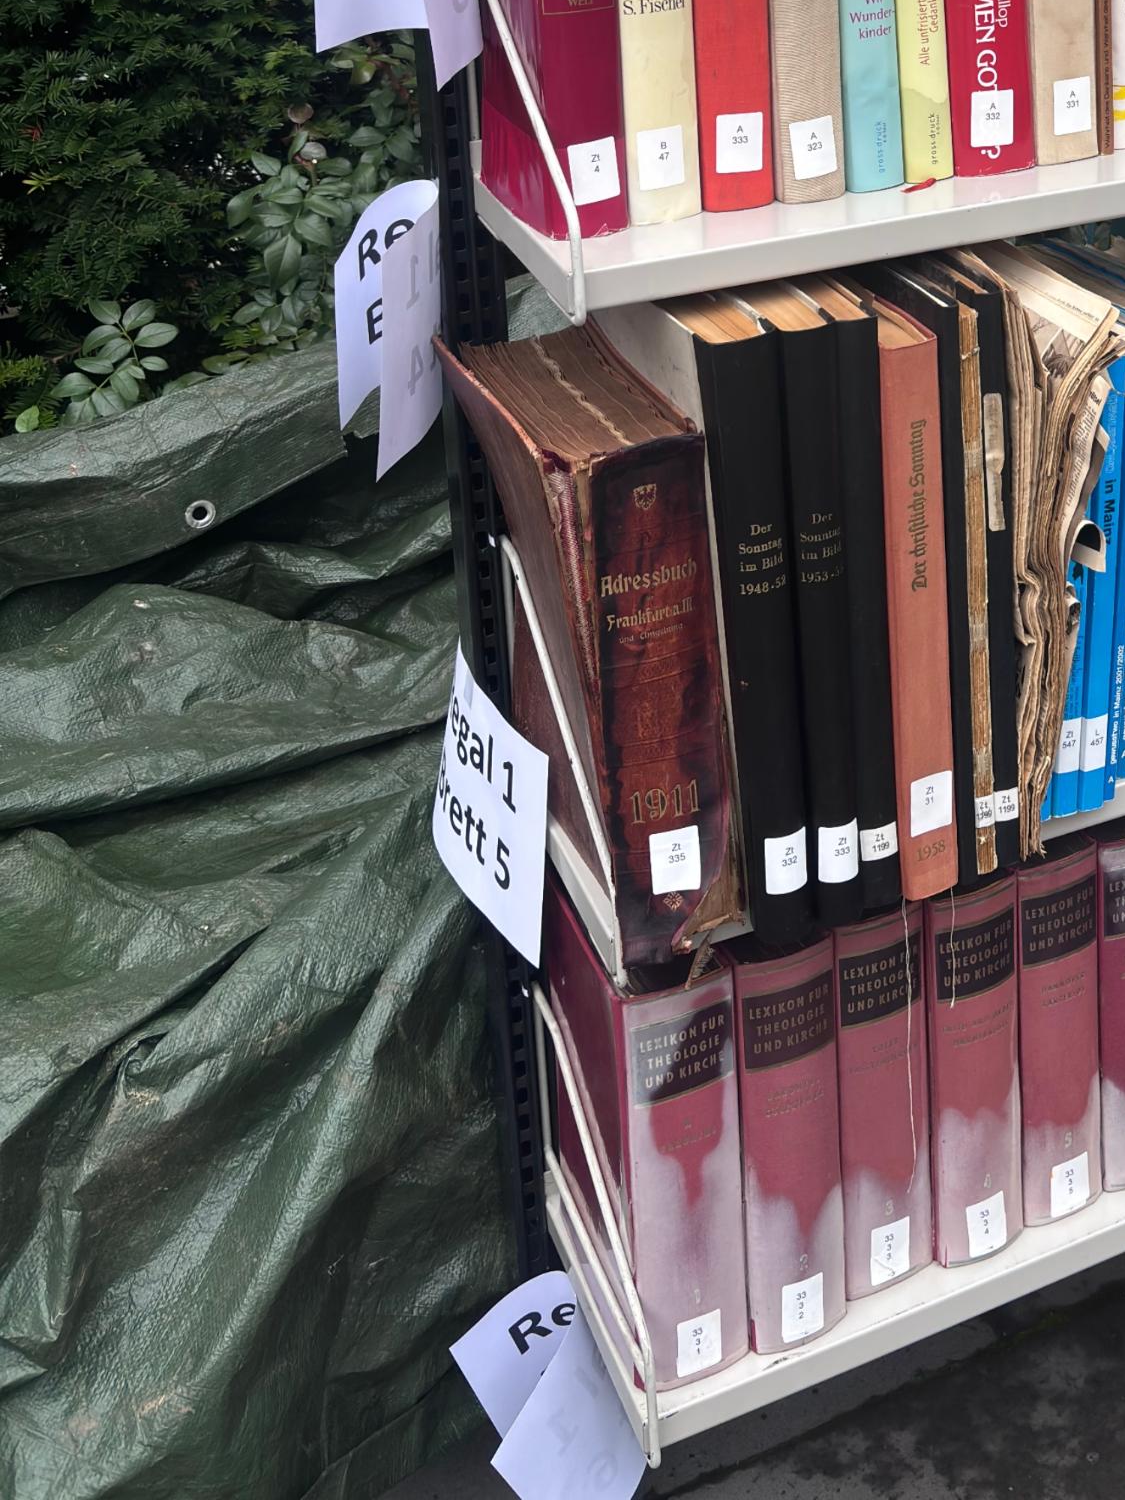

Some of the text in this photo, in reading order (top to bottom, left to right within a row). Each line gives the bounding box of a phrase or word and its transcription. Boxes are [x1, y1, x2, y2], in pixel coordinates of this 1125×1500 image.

[624, 5, 635, 14] S.
[849, 9, 895, 23] Wunder-
[858, 26, 892, 39] kinder
[984, 111, 1001, 120] 332
[731, 134, 749, 144] 333
[806, 141, 823, 151] 323
[600, 557, 697, 598] Adressbuch
[451, 686, 516, 813] egal 1
[630, 779, 701, 825] 1911
[494, 836, 510, 890] 5
[639, 1025, 698, 1054] LEXIKON
[647, 1036, 721, 1070] THEOLOGIE
[645, 1051, 725, 1089] UND KIRCHE
[692, 1327, 703, 1337] 33
